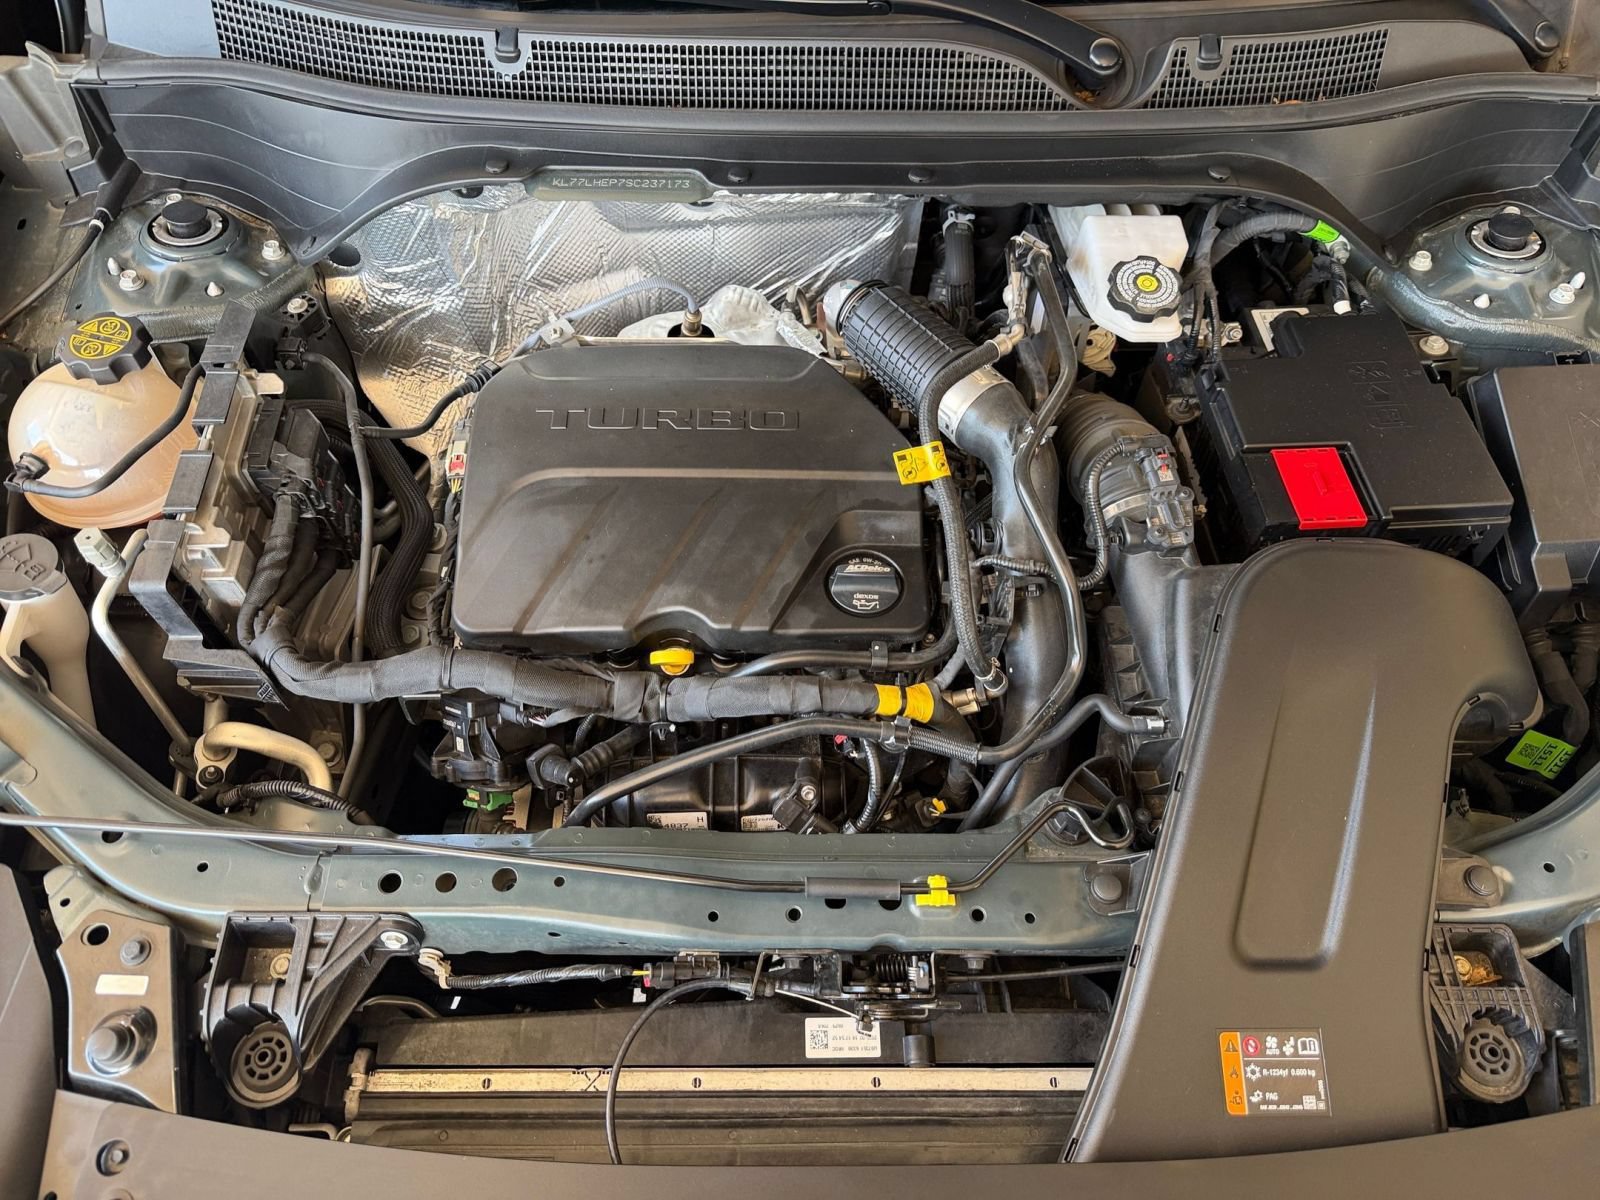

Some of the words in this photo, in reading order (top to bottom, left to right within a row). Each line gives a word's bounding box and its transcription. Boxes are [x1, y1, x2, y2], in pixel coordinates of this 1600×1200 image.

[552, 177, 690, 189] KL77LHEP7SC237173
[535, 407, 800, 431] TURBO
[844, 564, 890, 572] ACDelco
[1262, 1068, 1289, 1078] R-1234yf
[1308, 1068, 1316, 1077] kg
[1265, 1092, 1279, 1101] PAG
